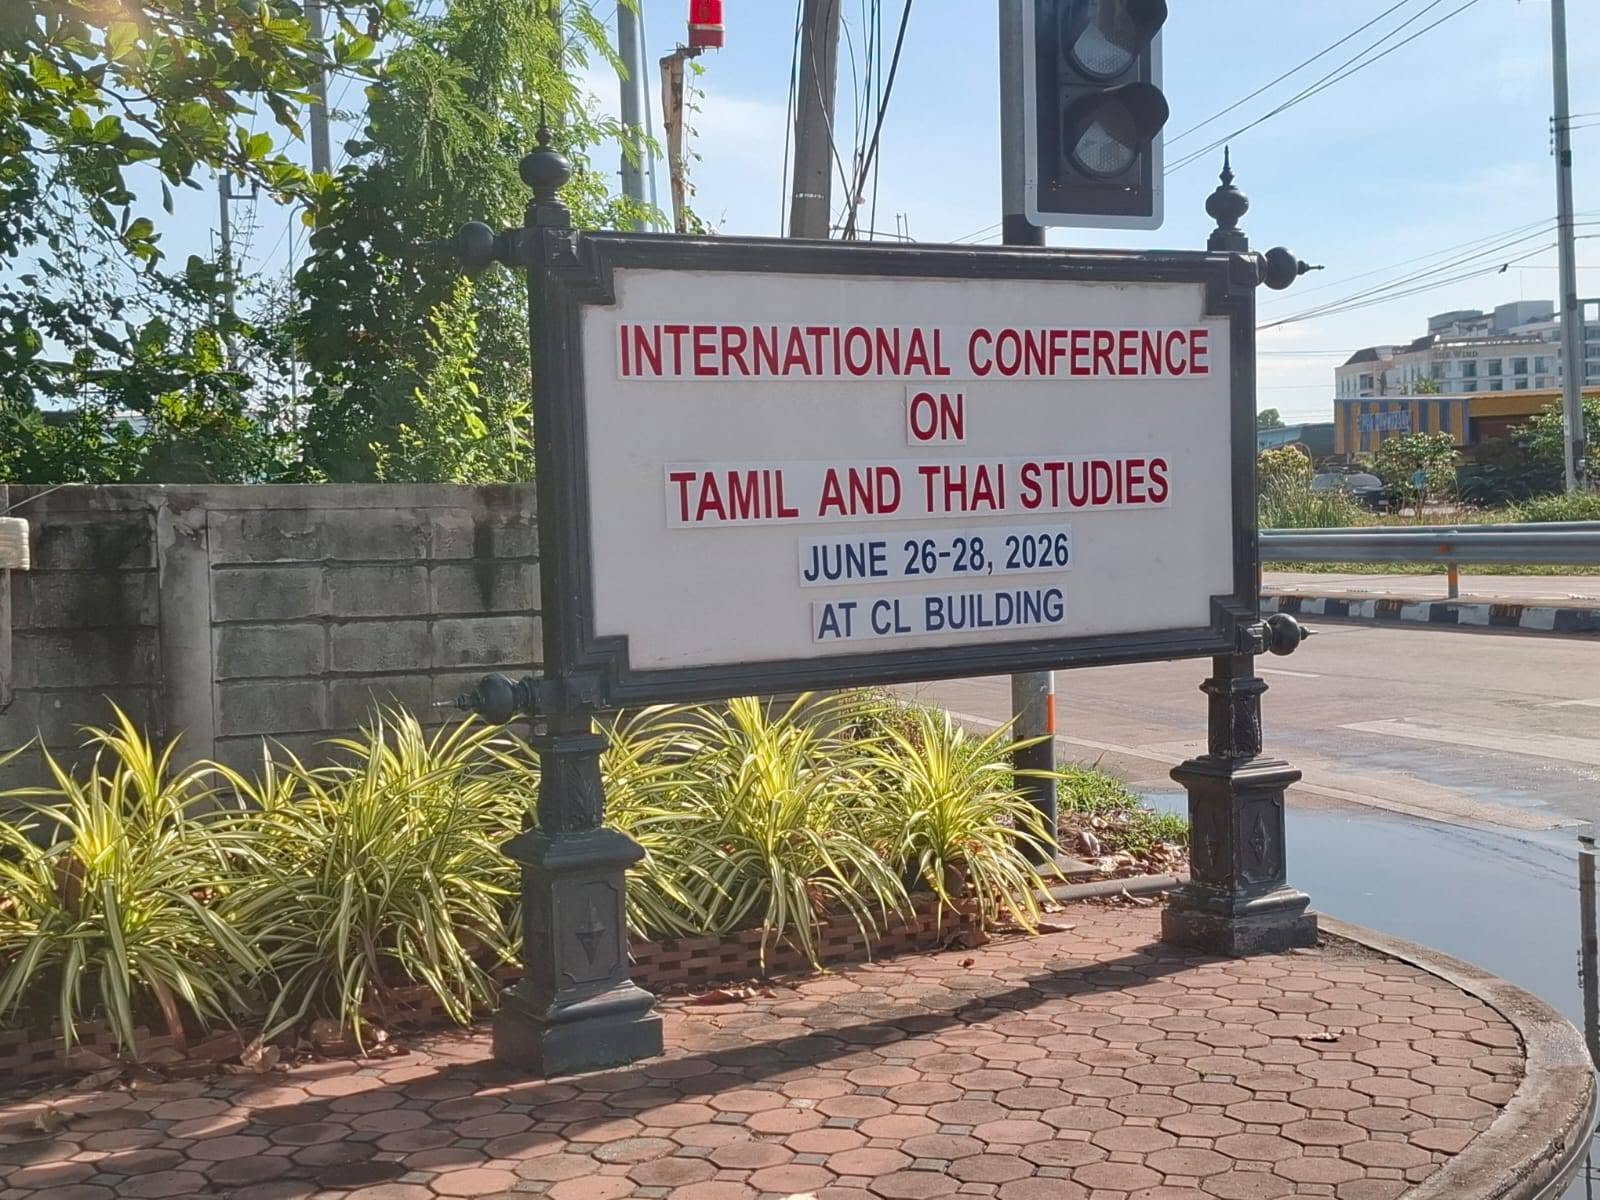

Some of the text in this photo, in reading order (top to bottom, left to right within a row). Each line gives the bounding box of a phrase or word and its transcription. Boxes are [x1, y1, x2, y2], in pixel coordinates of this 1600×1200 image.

[620, 325, 1209, 377] INTERNATIONAL CONFERENCE
[909, 392, 964, 441] ON
[670, 458, 1168, 521] TAMIL AND THAI STUDIES
[804, 532, 1069, 582] JUNE 26-28, 2026
[818, 588, 1064, 639] AT CL BUILDING
